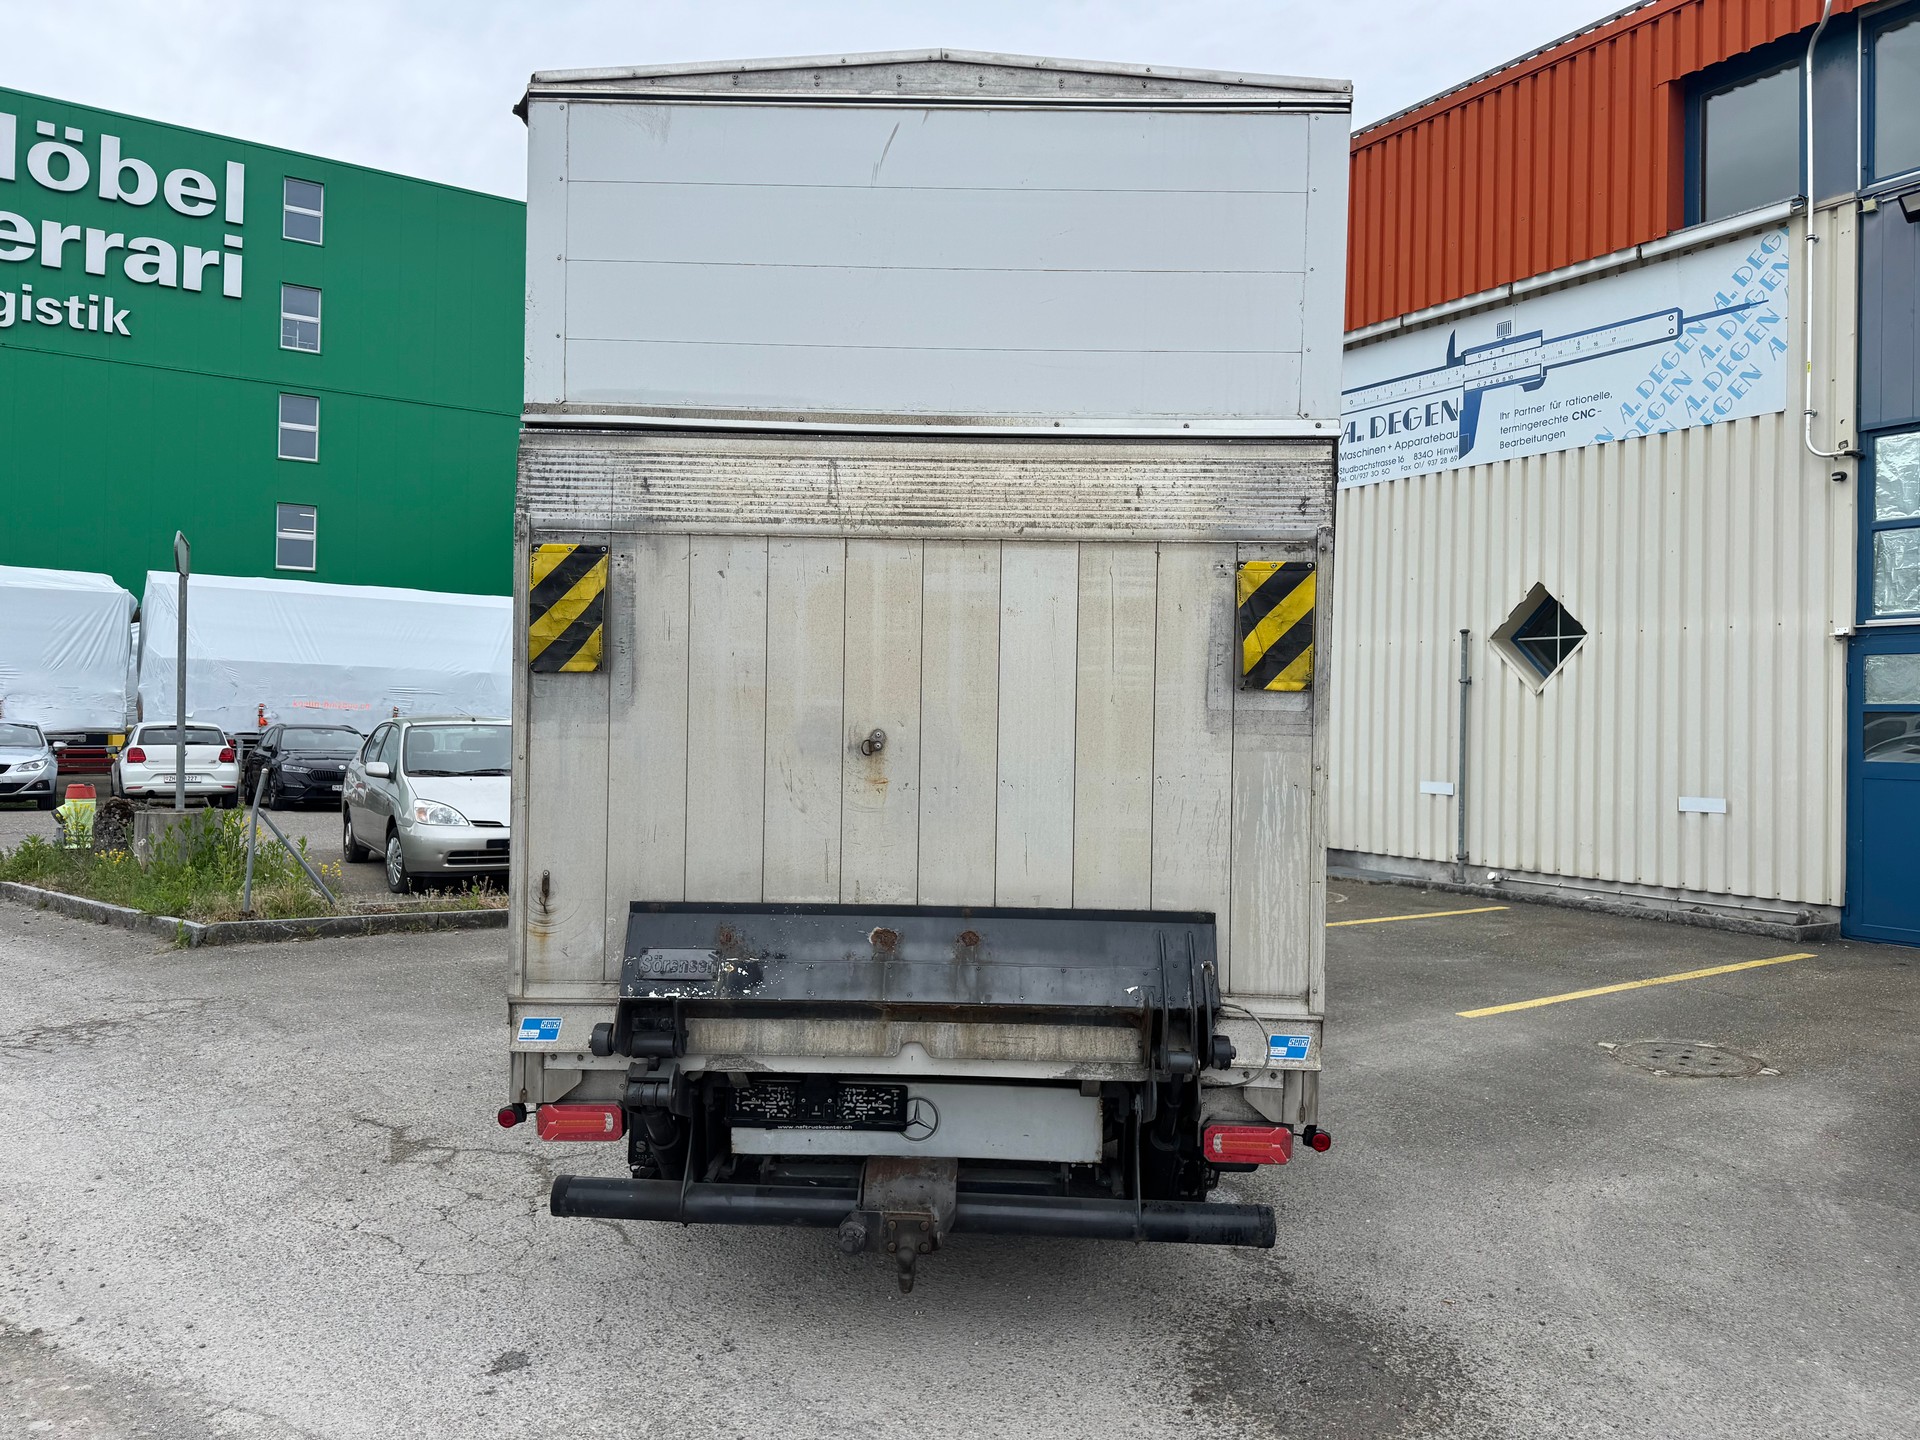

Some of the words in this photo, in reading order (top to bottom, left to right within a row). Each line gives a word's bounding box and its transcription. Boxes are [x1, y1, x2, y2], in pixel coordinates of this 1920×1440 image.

[1732, 227, 1790, 287] DEG
[1635, 320, 1708, 400] DEGEN
[1702, 307, 1781, 393] DEGEN
[1340, 421, 1364, 445] A.
[1370, 397, 1458, 439] DEGEN
[1500, 411, 1510, 420] Ihr
[1514, 404, 1546, 417] Partner
[1549, 400, 1562, 410] für
[1565, 391, 1613, 406] rationelle,
[1500, 414, 1568, 434] termingerechte
[1500, 430, 1566, 449] Bearbeitungen
[1340, 445, 1386, 461] Maschinen
[1394, 430, 1458, 452] Apparatebau
[1414, 450, 1434, 460] 8340
[1437, 445, 1458, 456] Hinwil
